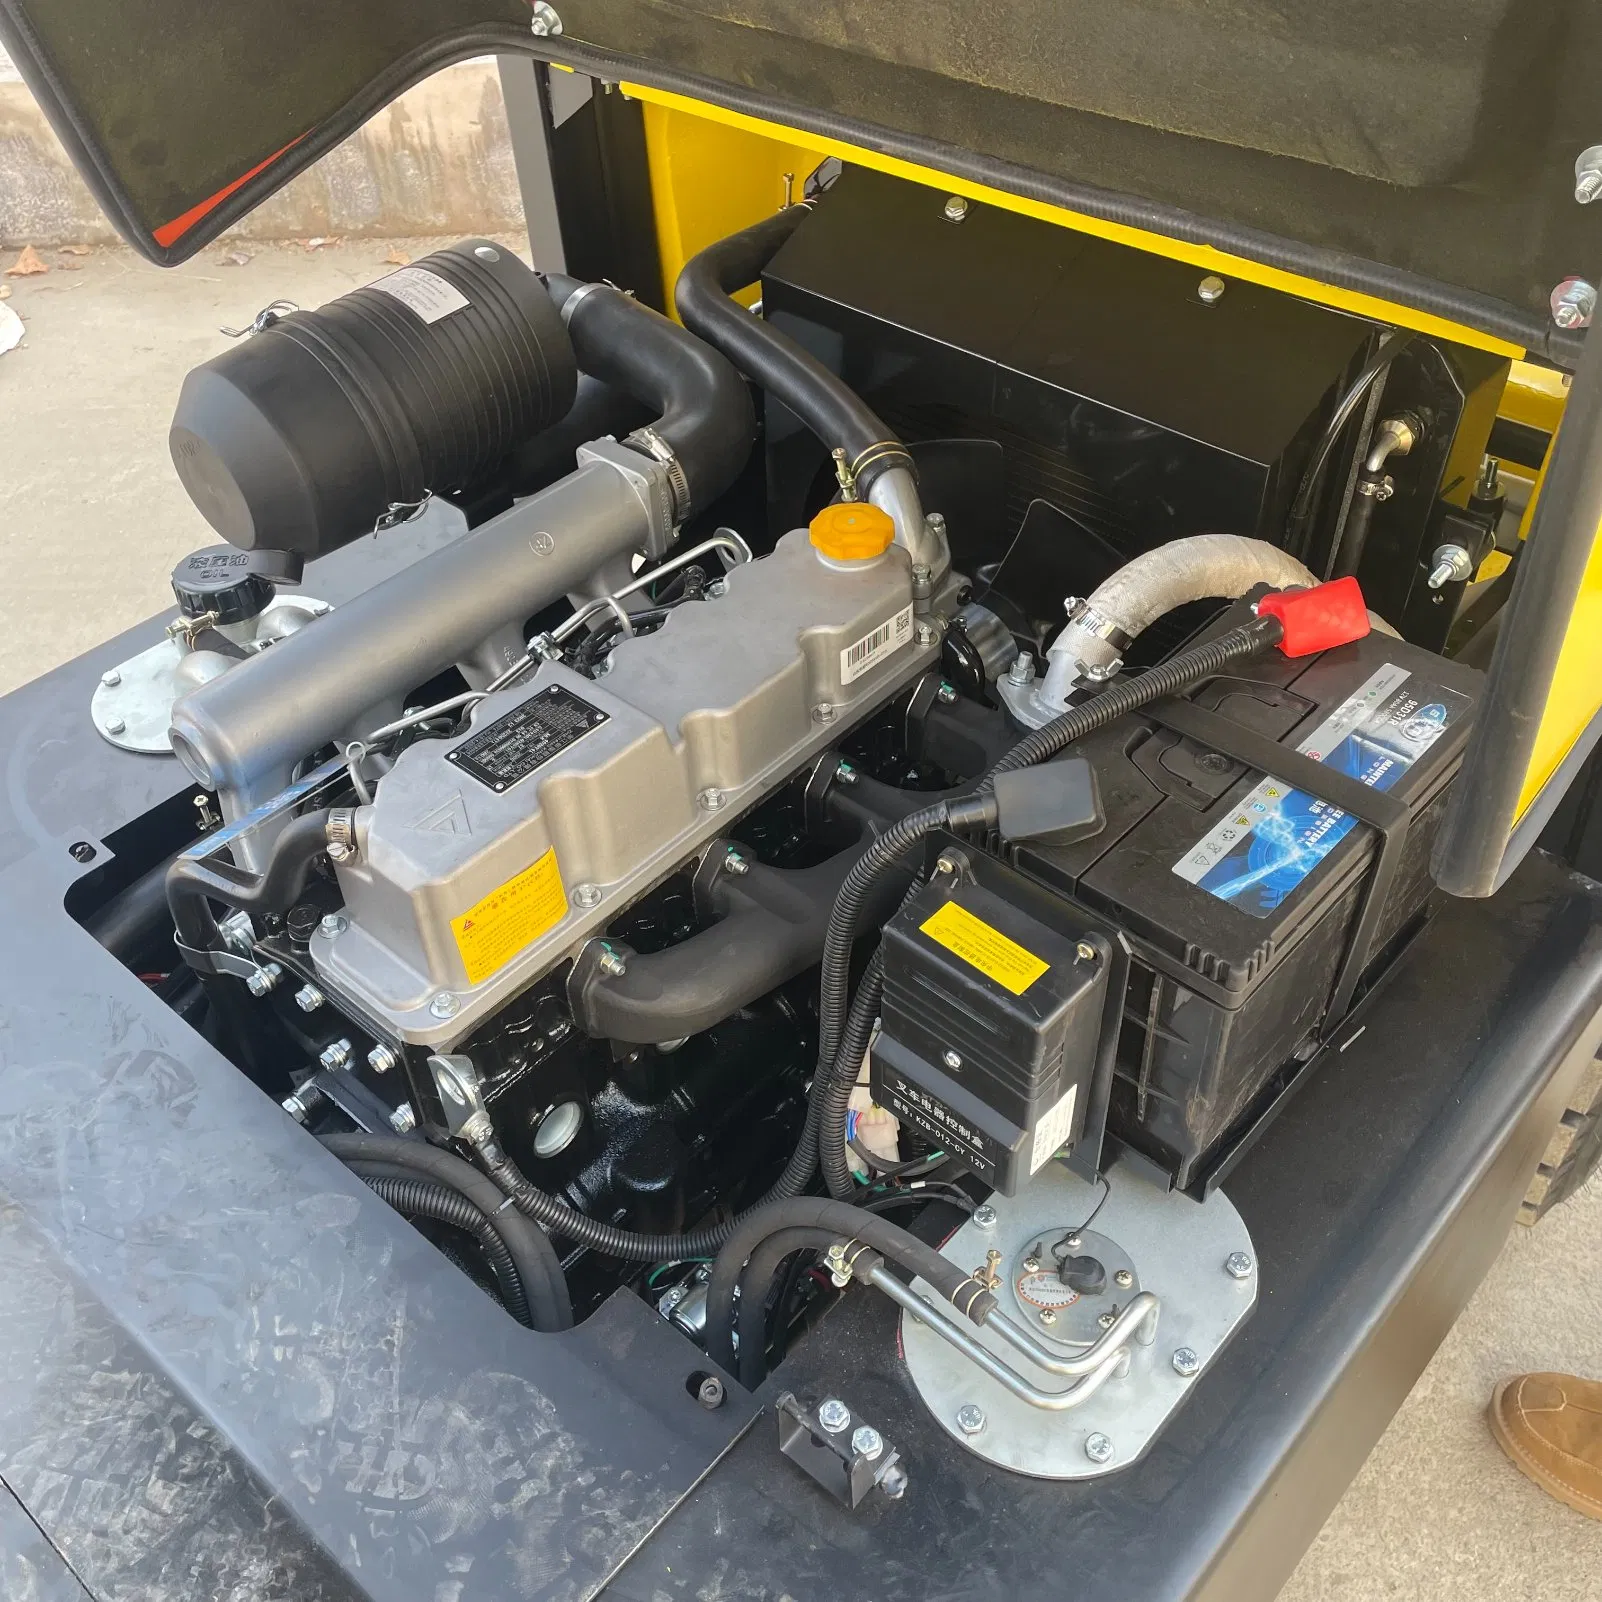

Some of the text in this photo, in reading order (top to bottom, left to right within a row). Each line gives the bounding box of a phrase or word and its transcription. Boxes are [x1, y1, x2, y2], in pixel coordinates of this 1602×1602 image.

[188, 553, 248, 568] 液压油
[200, 568, 229, 578] OIL
[1387, 699, 1418, 726] 95D31R
[1303, 817, 1336, 847] BATTERY
[896, 1079, 983, 1149] 叉车电器控制盒
[969, 1155, 985, 1169] 12V
